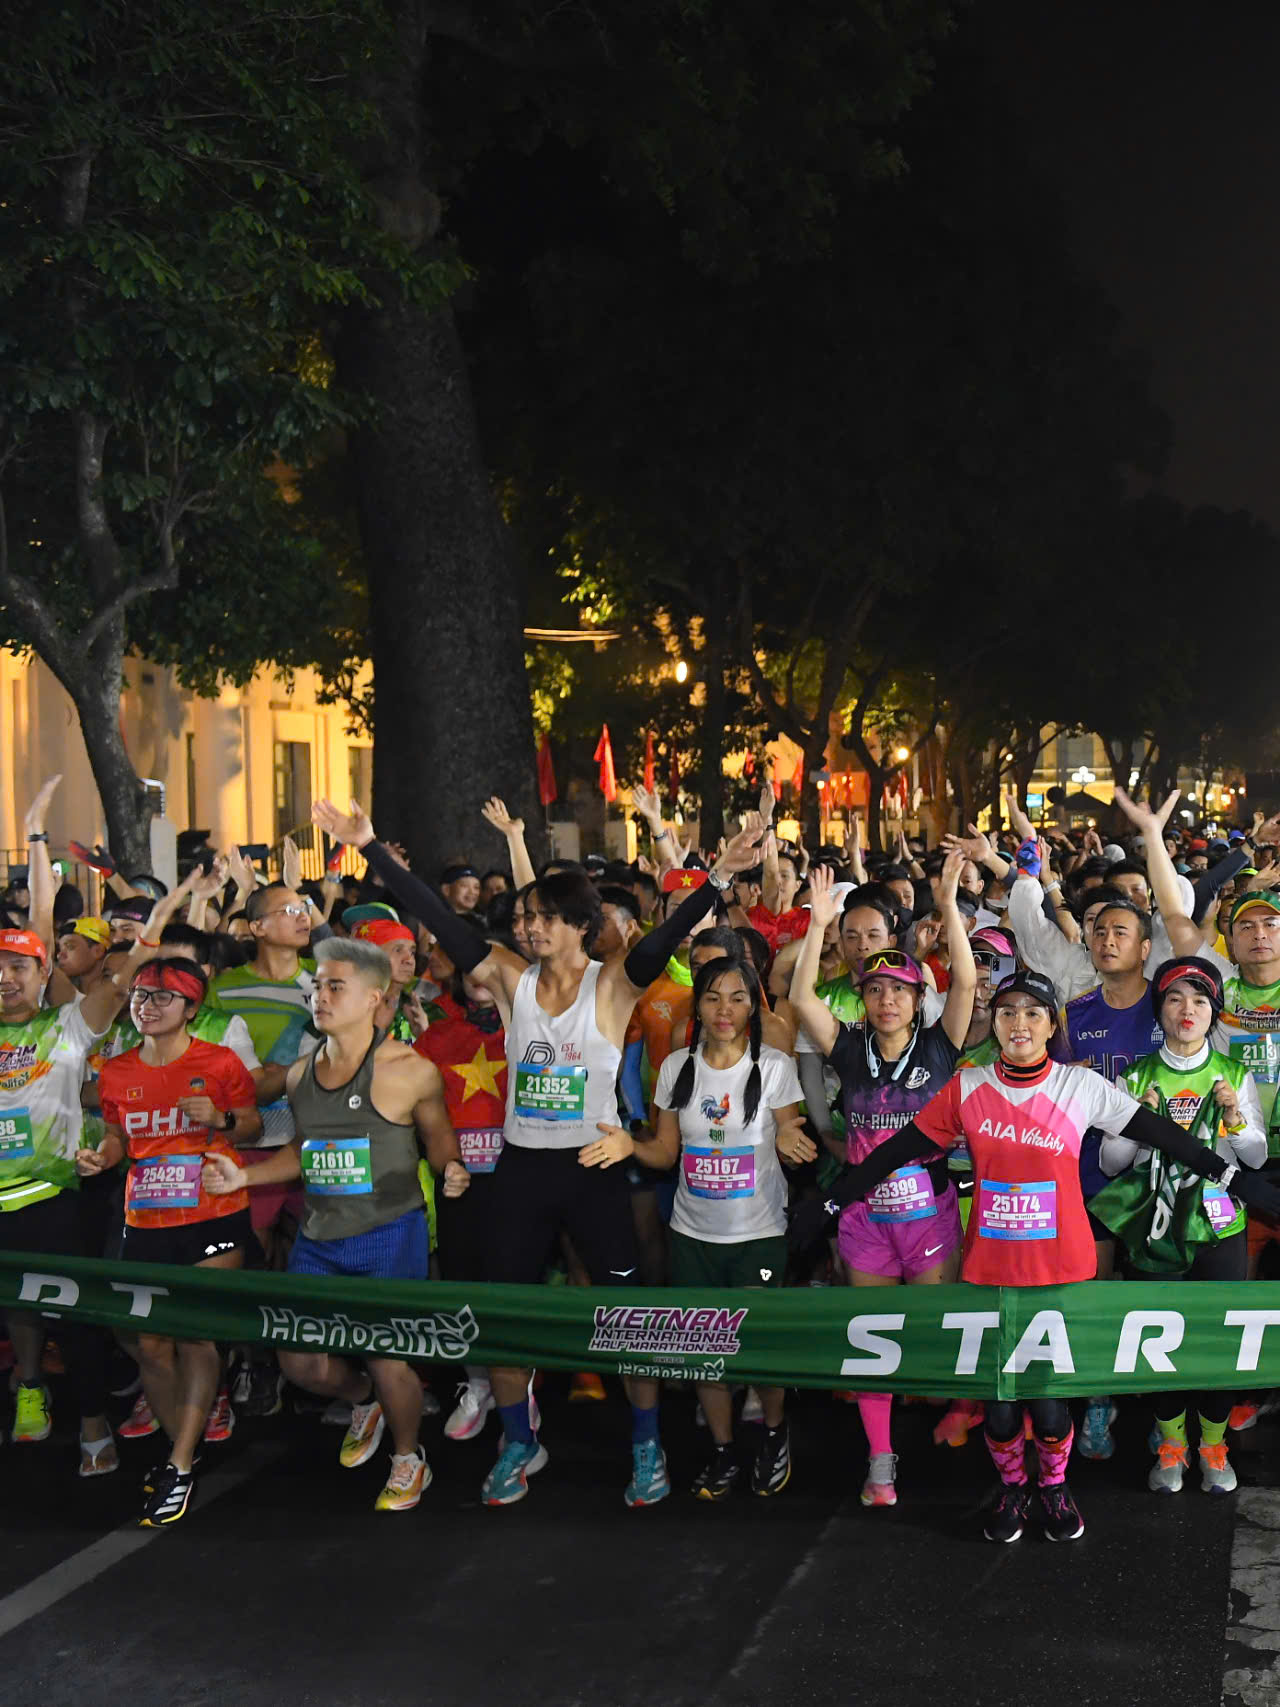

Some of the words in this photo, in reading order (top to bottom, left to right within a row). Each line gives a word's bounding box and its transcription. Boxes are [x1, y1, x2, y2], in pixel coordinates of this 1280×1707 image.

[1077, 1029, 1109, 1041] Lexar
[526, 1075, 570, 1094] 21352
[978, 1118, 1017, 1142] AIA
[1020, 1126, 1065, 1157] Vitality
[312, 1151, 355, 1169] 21610
[695, 1157, 740, 1175] 25167
[142, 1166, 186, 1184] 25429
[874, 1177, 918, 1199] 25399
[992, 1194, 1041, 1213] 25174
[594, 1305, 749, 1332] VIETNAM
[259, 1304, 472, 1359] Herbalife
[595, 1328, 740, 1344] INTERNATIONAL
[590, 1339, 625, 1350] HALF
[628, 1340, 705, 1352] MARATHON
[706, 1344, 740, 1353] 2025
